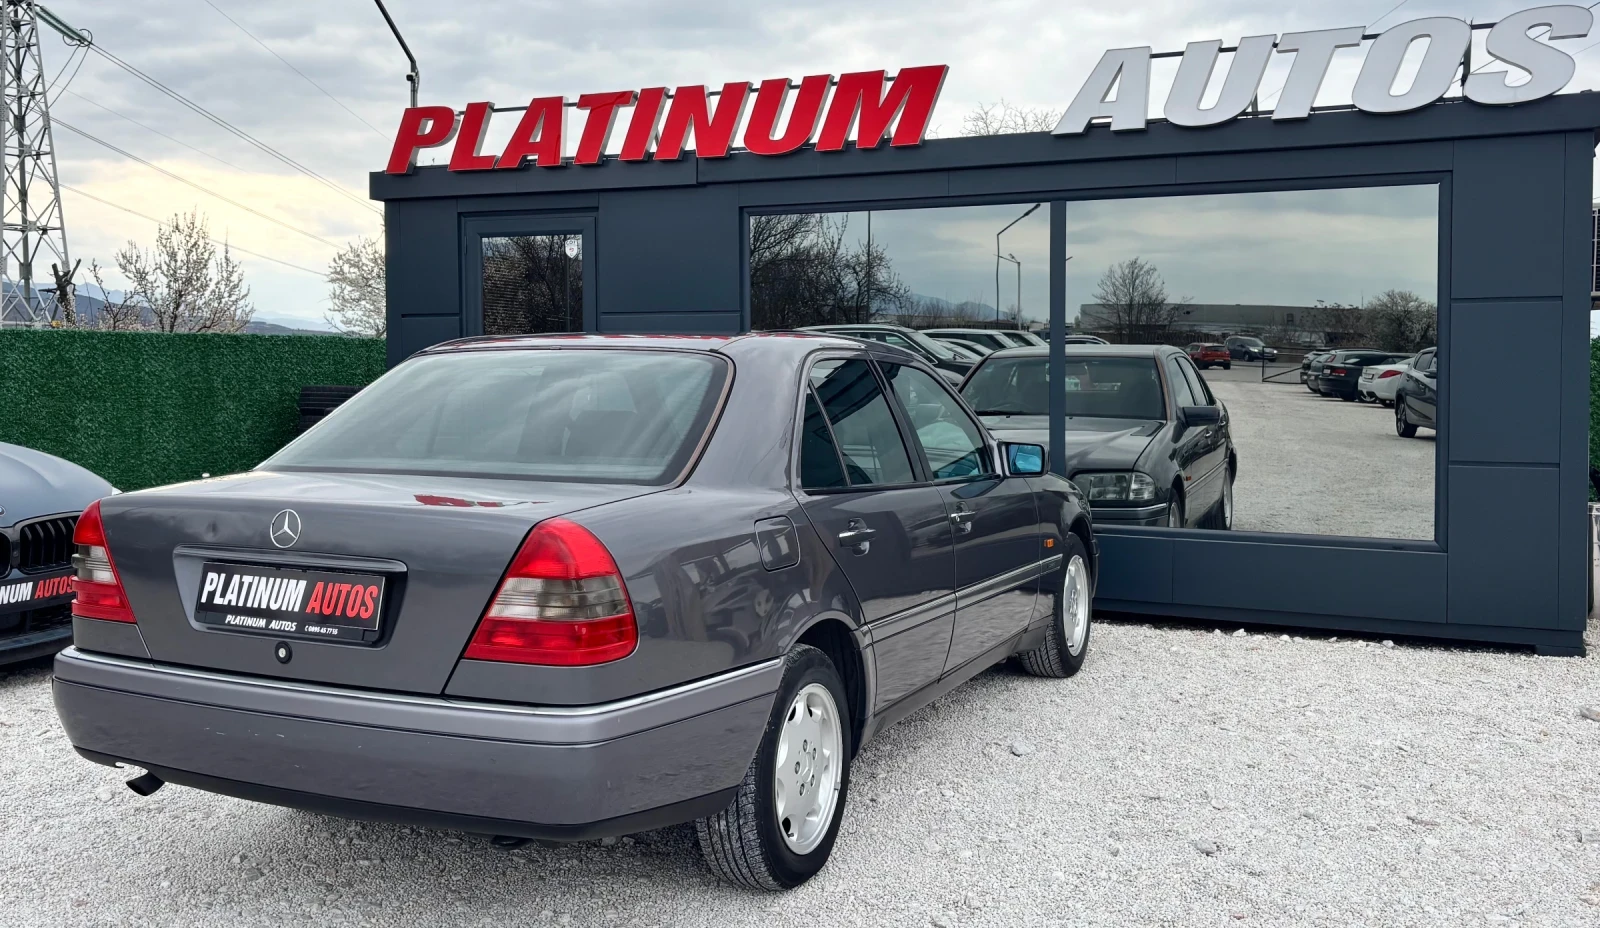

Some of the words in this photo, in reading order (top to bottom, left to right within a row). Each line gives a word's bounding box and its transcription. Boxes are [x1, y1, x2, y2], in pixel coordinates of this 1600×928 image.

[385, 64, 950, 175] PLATINUM
[1051, 5, 1594, 135] AUTOS
[201, 572, 307, 612] PLATINUM
[305, 581, 379, 619] AUTOS
[225, 615, 266, 628] PLATINUM
[269, 620, 297, 632] AUTOS
